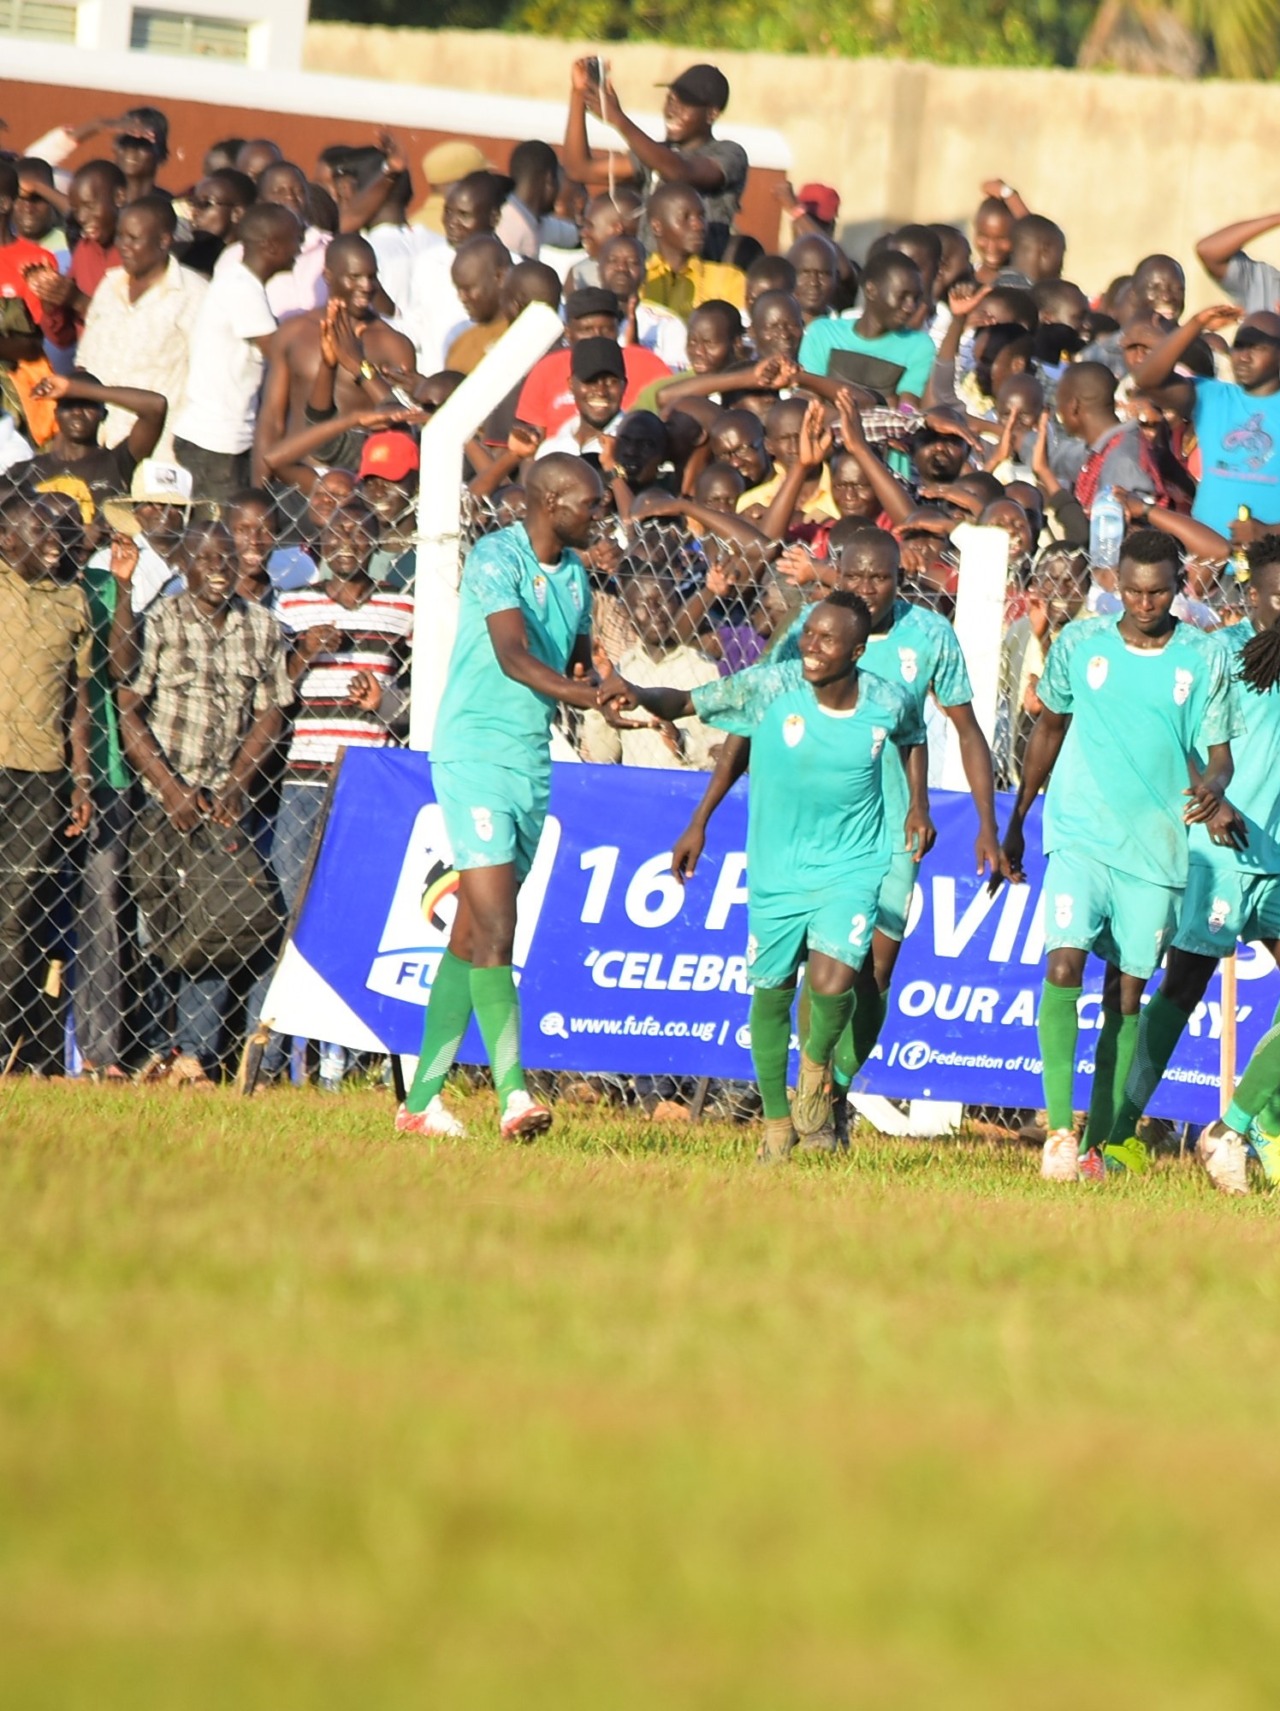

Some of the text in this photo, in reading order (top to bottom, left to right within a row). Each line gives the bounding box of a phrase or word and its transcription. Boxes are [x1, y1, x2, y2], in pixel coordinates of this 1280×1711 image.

[580, 845, 685, 928] 16
[848, 913, 867, 948] 2
[898, 980, 1000, 1024] OUR
[570, 1014, 716, 1042] www.fufa.co.ug
[928, 1050, 1003, 1070] Federation
[1005, 1055, 1023, 1071] of
